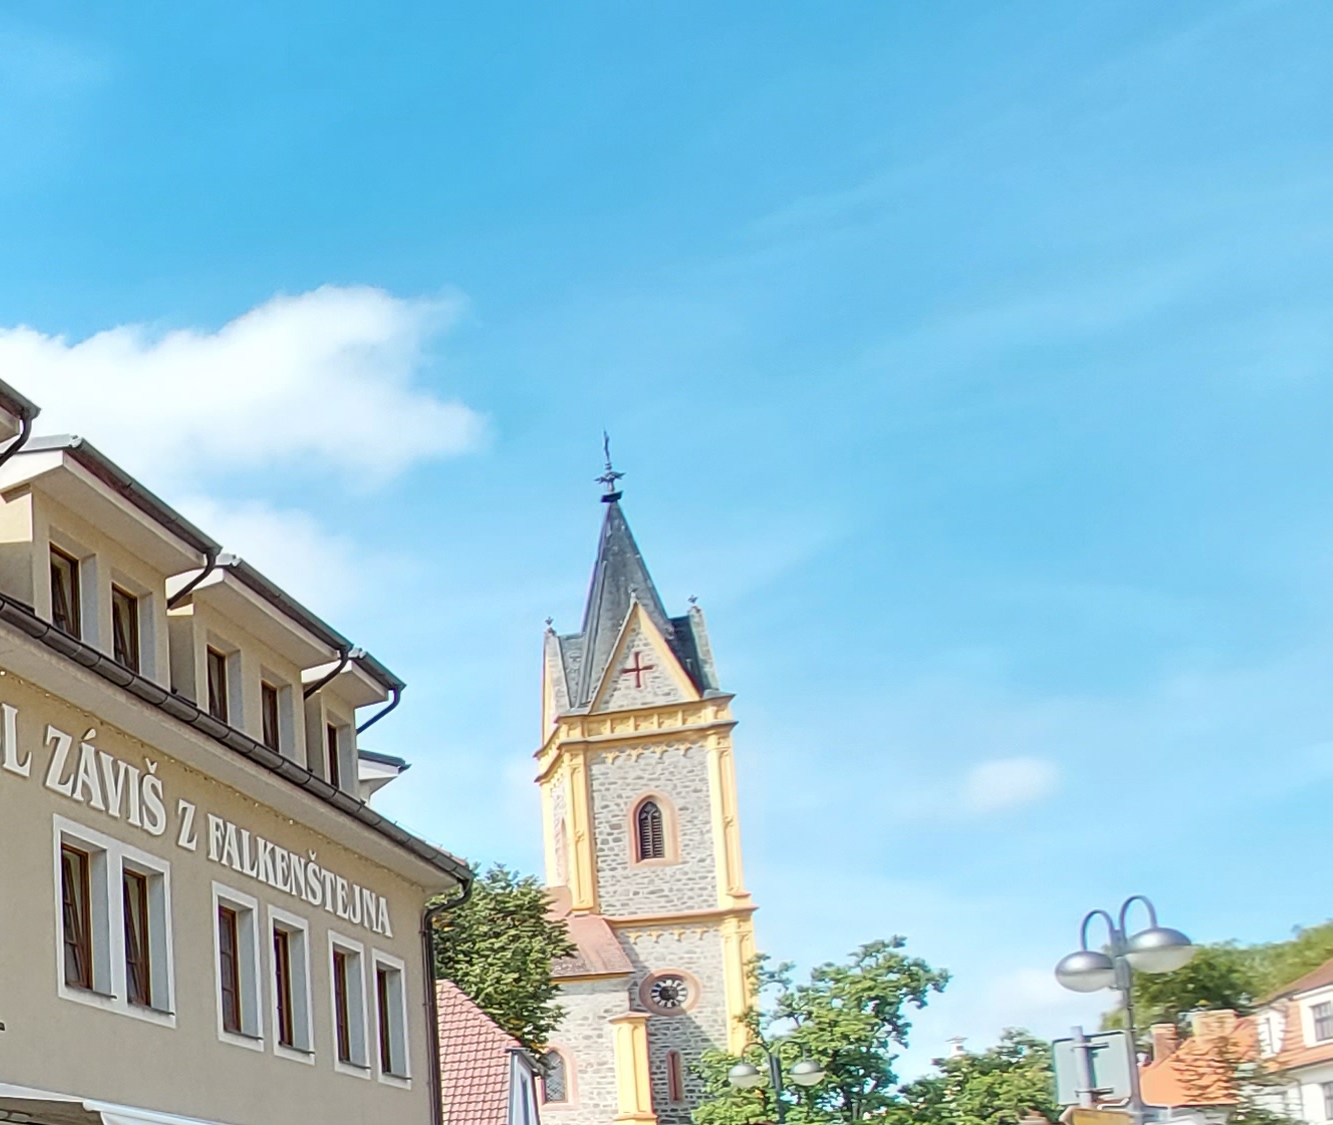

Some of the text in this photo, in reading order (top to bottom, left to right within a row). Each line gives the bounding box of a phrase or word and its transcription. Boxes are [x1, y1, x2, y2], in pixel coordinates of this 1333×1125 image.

[44, 724, 167, 836] ZÁVIŠ
[177, 799, 198, 851] Z
[207, 814, 393, 938] FALKENŠTEJNA
